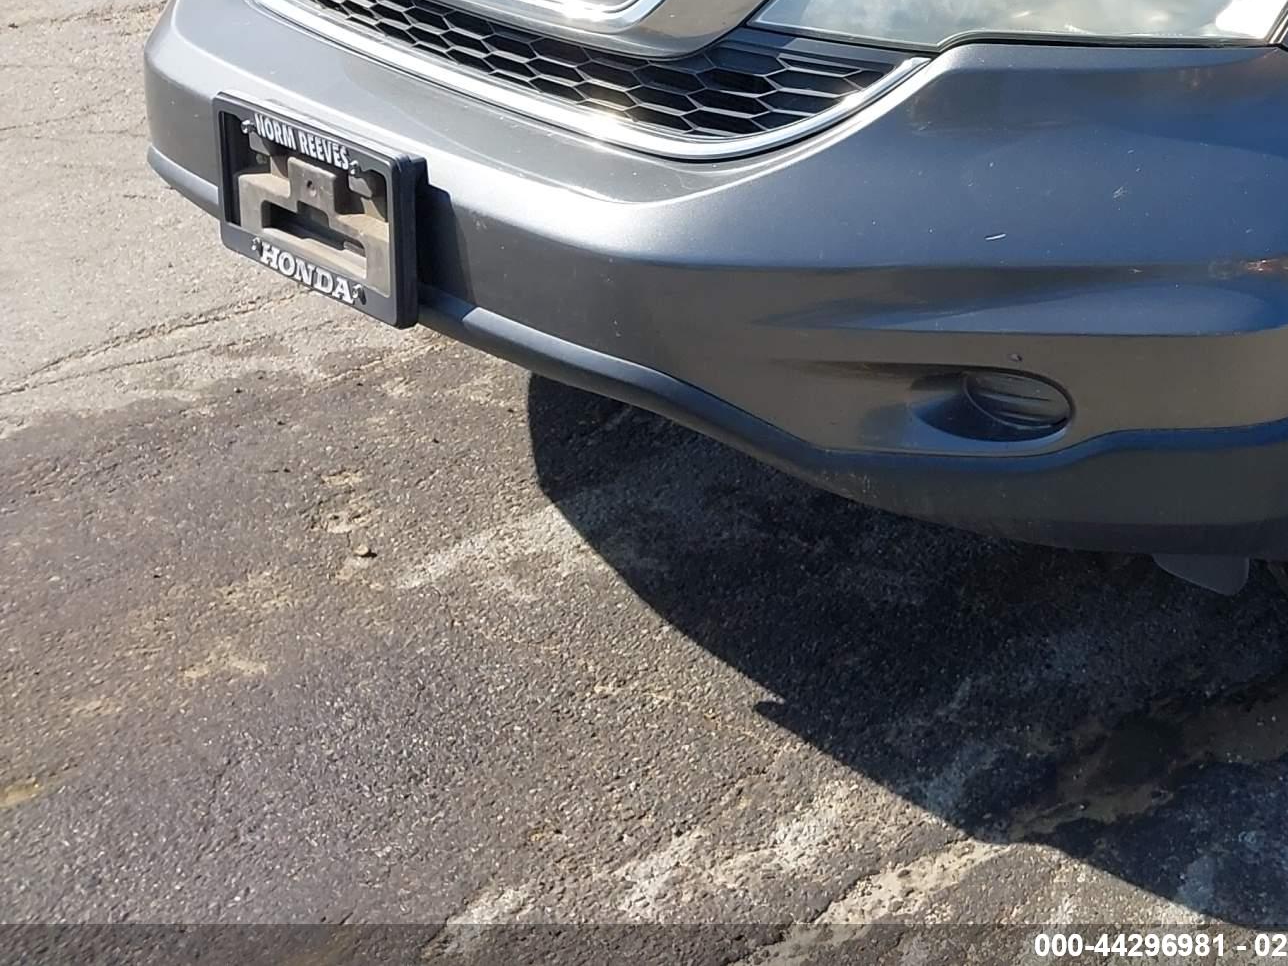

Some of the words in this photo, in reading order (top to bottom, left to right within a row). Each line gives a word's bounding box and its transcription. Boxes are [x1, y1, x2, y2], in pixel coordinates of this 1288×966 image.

[254, 113, 297, 151] NORM
[299, 132, 349, 170] REEVES
[261, 242, 354, 305] HONDA
